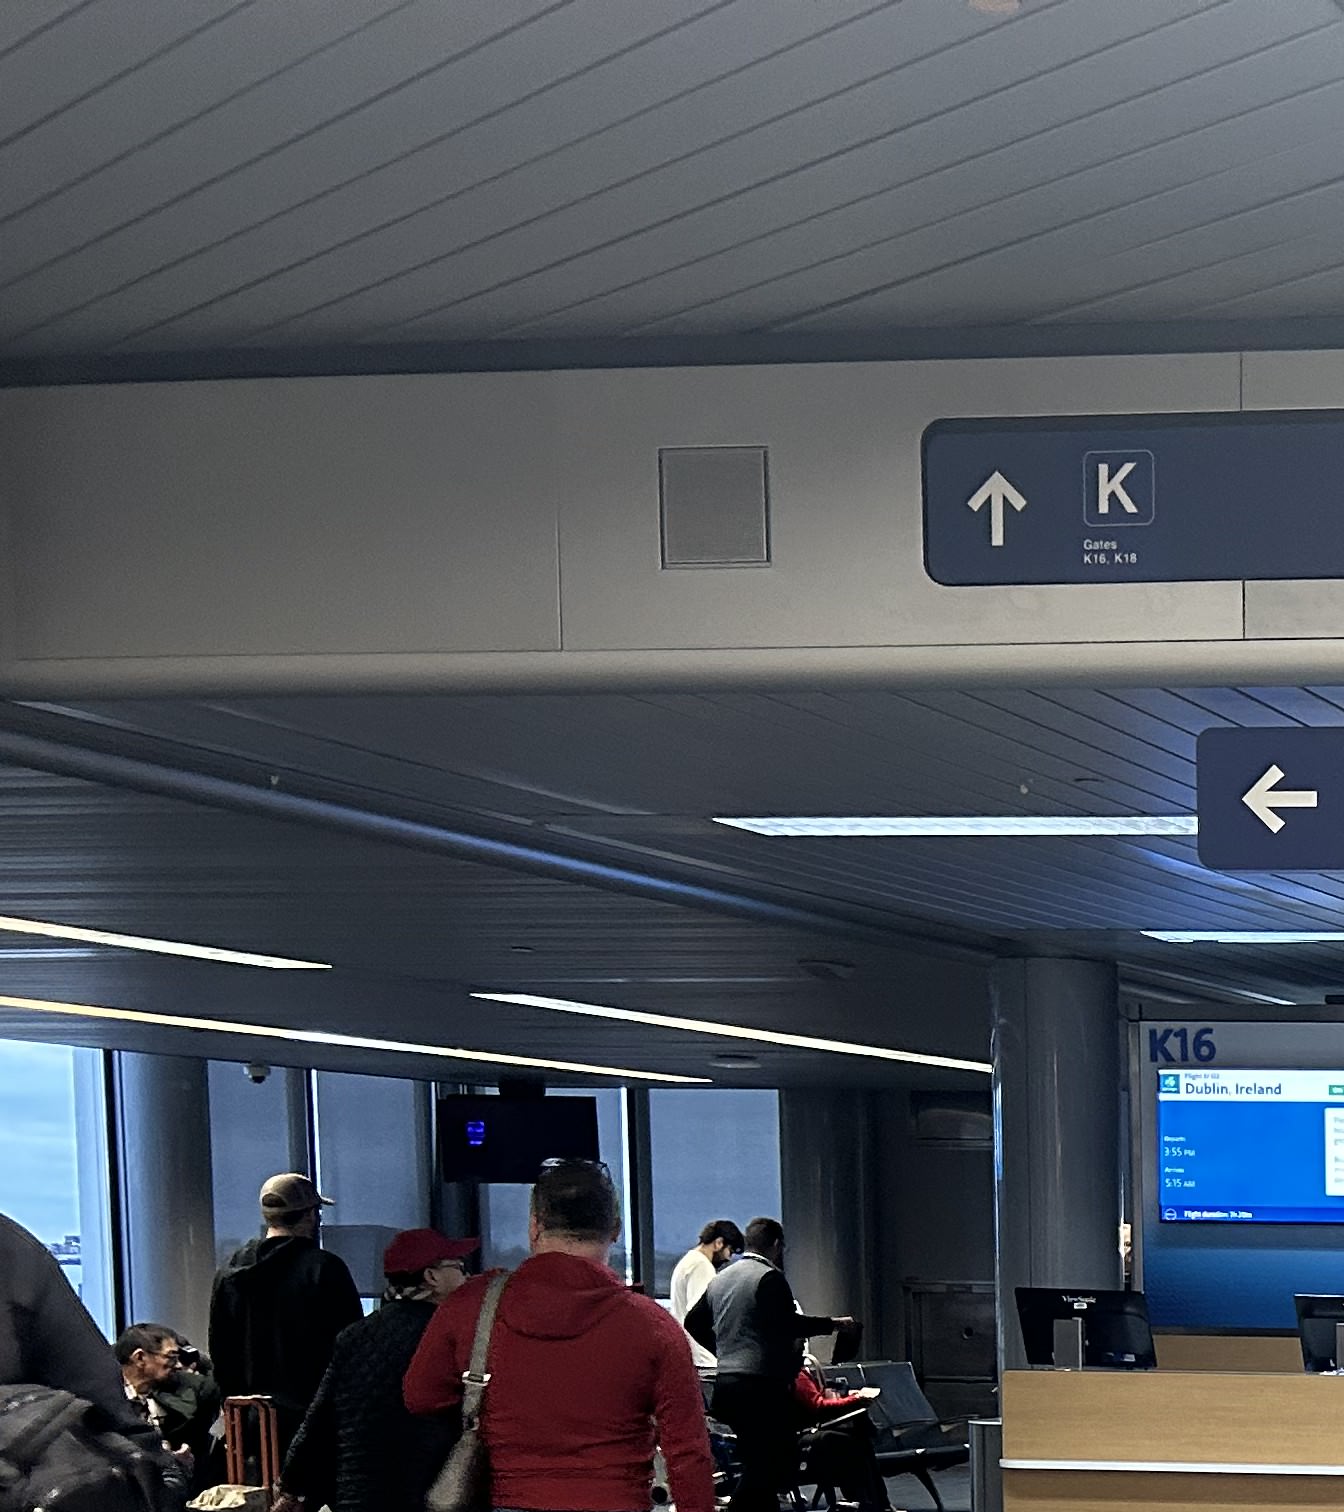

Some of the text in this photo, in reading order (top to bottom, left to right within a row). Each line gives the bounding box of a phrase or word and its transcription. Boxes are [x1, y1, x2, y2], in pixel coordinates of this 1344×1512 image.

[1098, 462, 1139, 514] K
[1083, 538, 1118, 551] Gates
[1114, 552, 1137, 564] K18
[1148, 1028, 1217, 1063] K16
[1185, 1082, 1282, 1096] Dublin, Ireland
